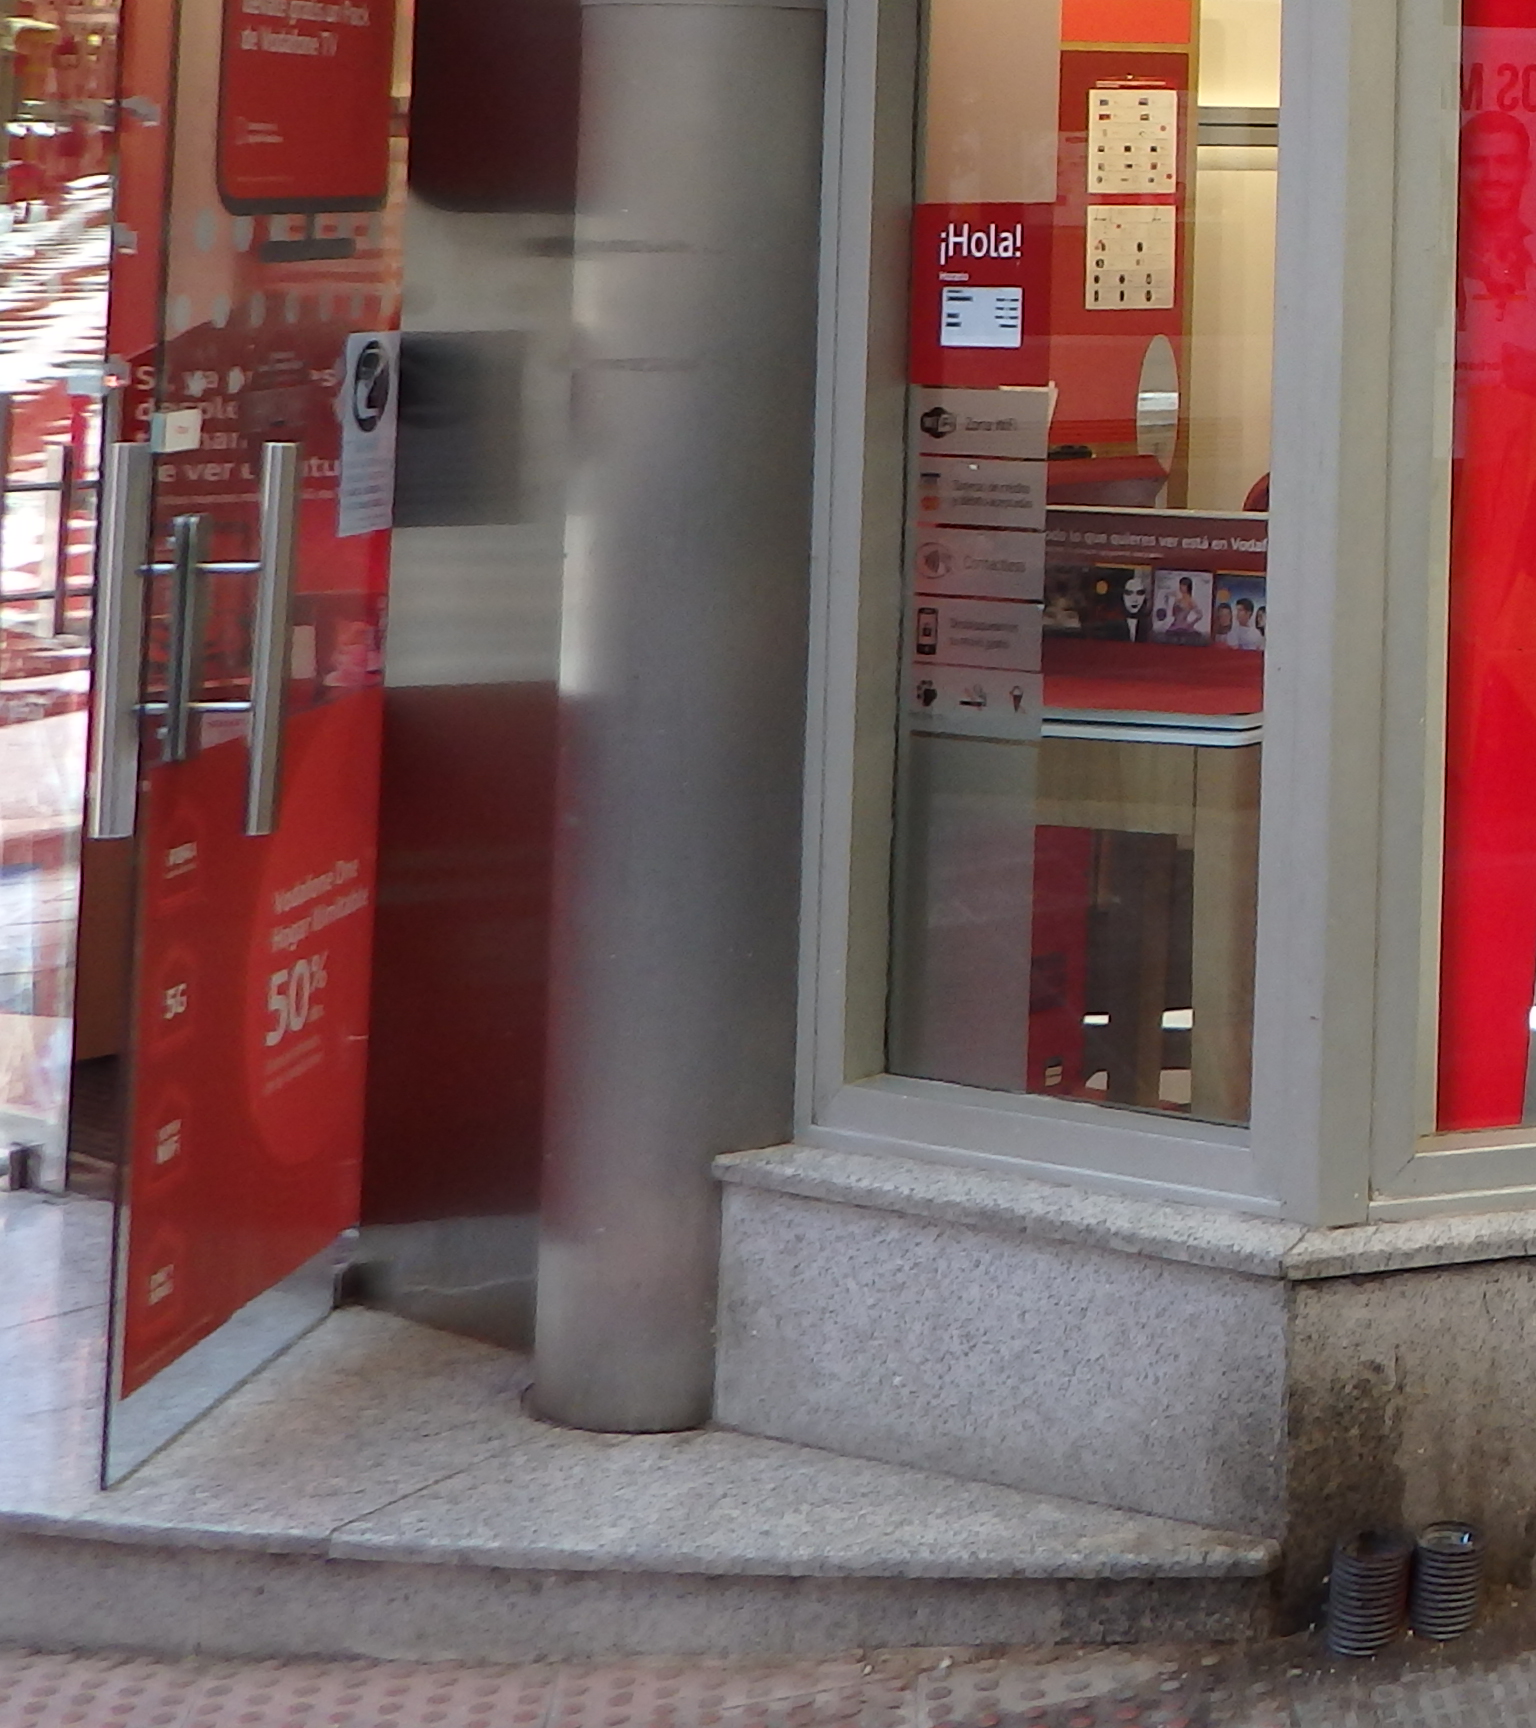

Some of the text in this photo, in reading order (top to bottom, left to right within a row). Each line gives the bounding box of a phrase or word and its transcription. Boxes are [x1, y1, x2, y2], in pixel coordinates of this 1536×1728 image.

[940, 223, 1021, 265] ¡Hola!
[1085, 532, 1107, 545] que
[1111, 531, 1155, 546] quieres
[1159, 537, 1178, 548] ver
[1182, 535, 1208, 549] está
[1211, 539, 1227, 550] en
[1231, 537, 1267, 552] Vodaf
